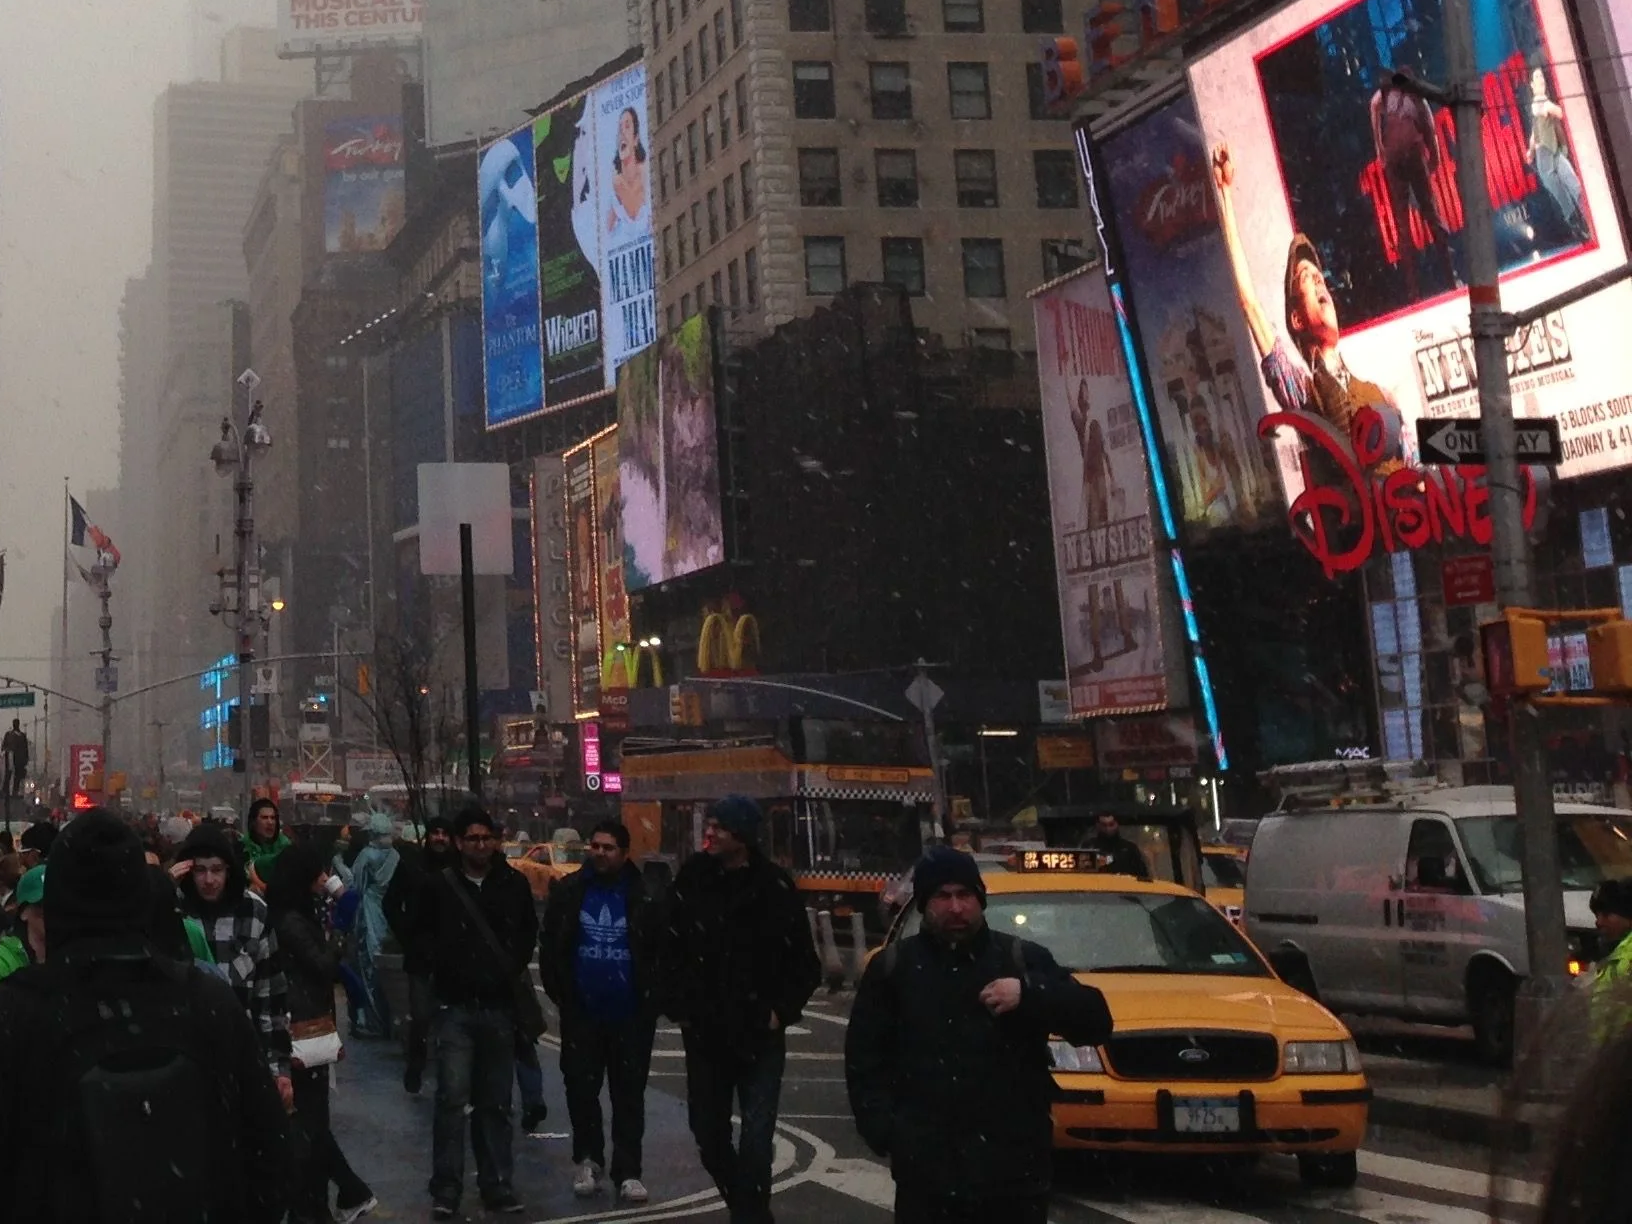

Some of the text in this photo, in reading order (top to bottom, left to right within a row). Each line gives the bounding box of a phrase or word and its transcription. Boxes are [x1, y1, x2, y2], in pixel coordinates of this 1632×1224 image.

[290, 7, 426, 30] THIS CENTU
[331, 137, 402, 162] Turkey
[488, 323, 537, 358] PHANTOM
[1537, 367, 1575, 389] MUSICAL
[1560, 412, 1569, 431] 5
[1569, 402, 1607, 430] BLOCKS
[1516, 432, 1541, 452] AY
[1562, 428, 1605, 461] OADWAY
[1608, 427, 1618, 450] &
[1065, 520, 1150, 572] NEWSIES
[1042, 853, 1076, 869] 9F25
